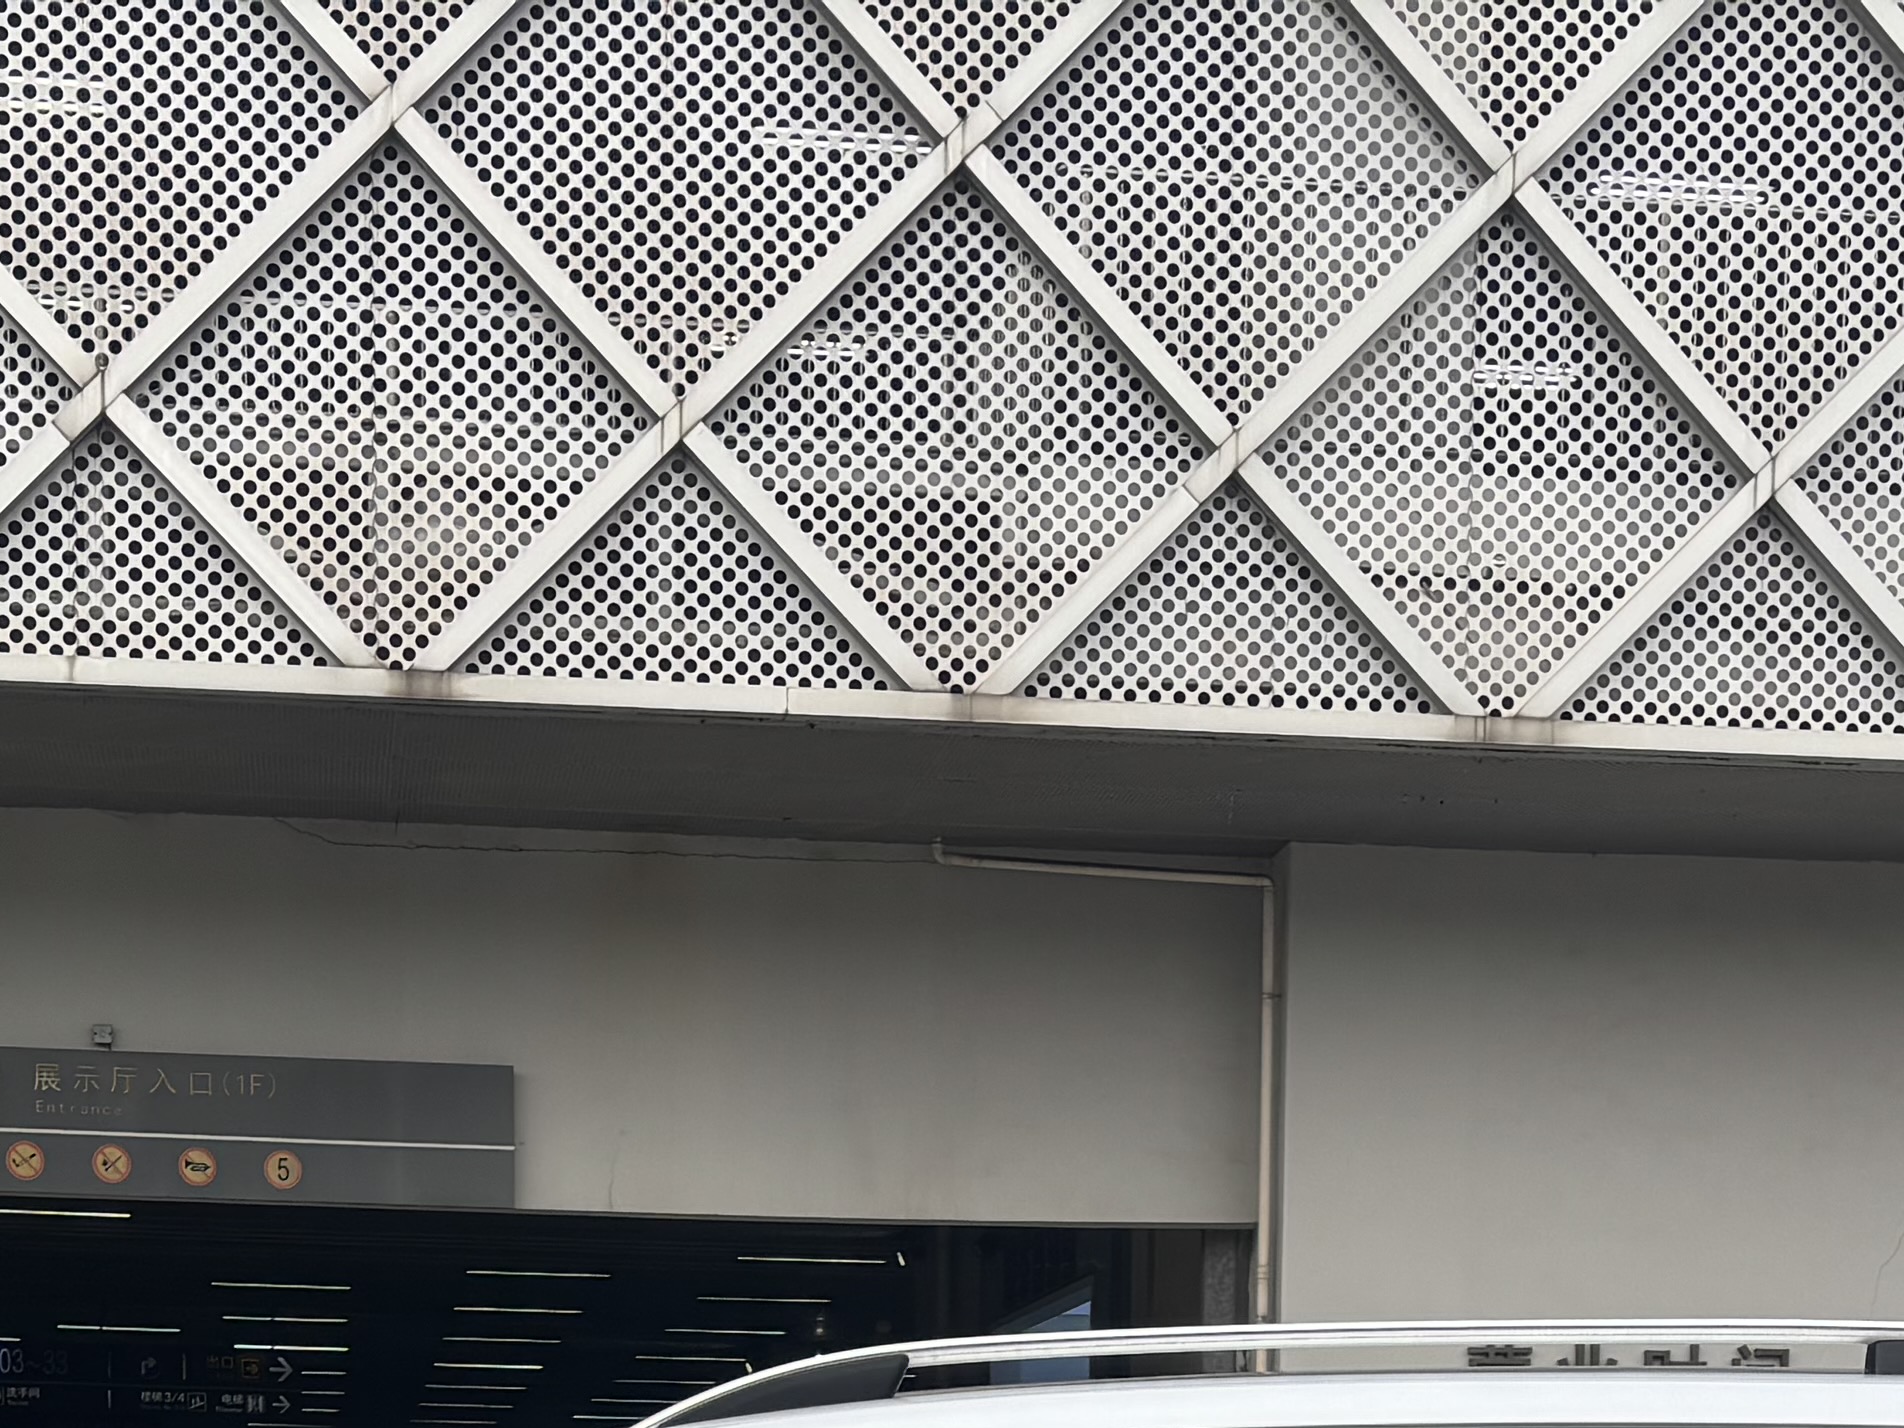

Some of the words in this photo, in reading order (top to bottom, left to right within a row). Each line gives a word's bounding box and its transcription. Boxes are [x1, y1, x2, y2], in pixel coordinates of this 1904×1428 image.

[33, 1062, 277, 1099] 展示厅入口(1F)
[35, 1099, 124, 1117] Entrance
[276, 1157, 290, 1182] 5
